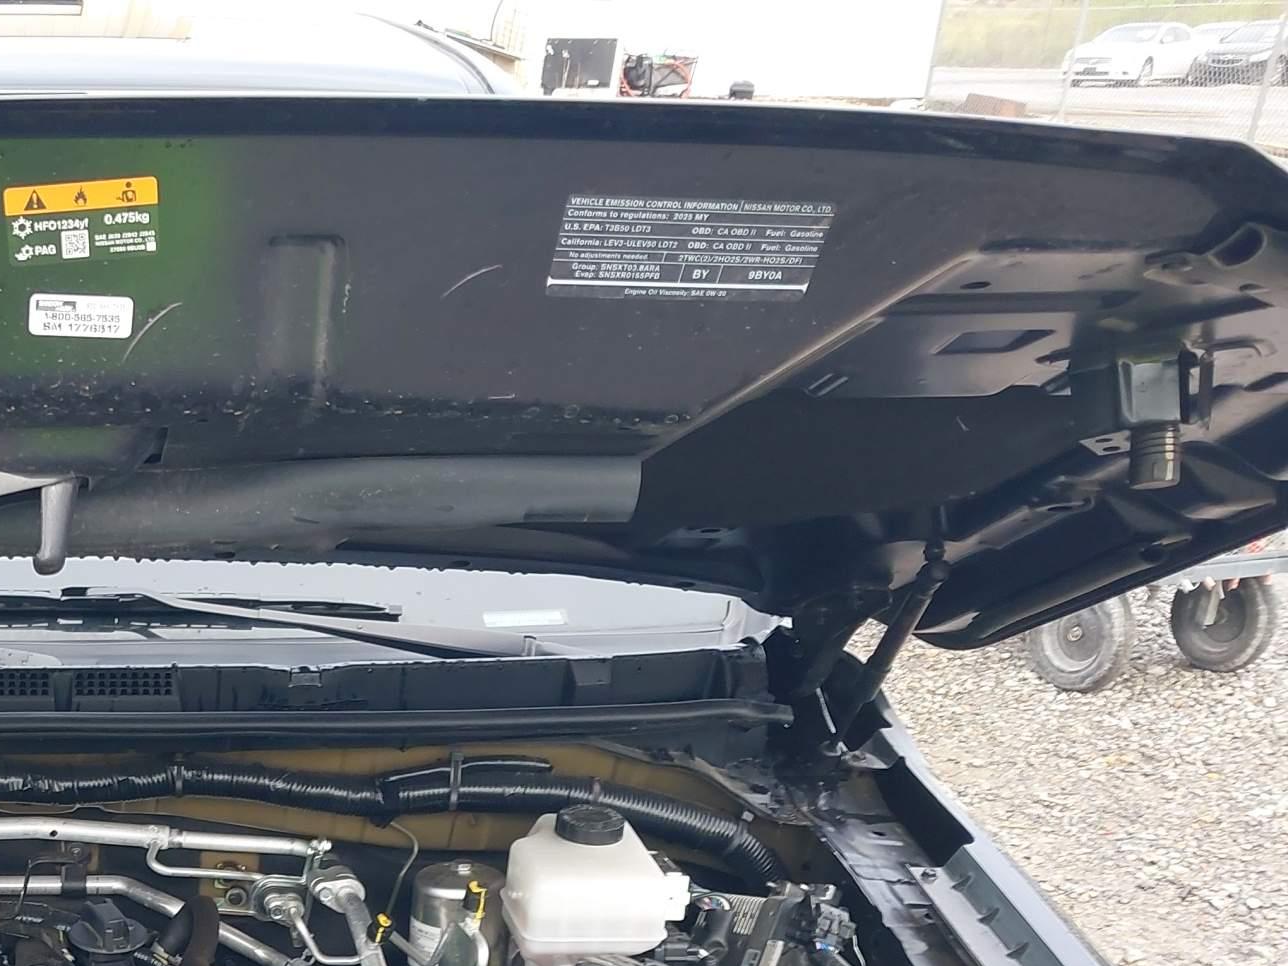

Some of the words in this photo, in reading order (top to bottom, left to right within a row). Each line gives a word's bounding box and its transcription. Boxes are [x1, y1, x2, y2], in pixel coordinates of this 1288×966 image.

[571, 197, 605, 206] VEHICLE
[605, 199, 644, 207] EMISSION
[646, 200, 682, 208] CONTROL
[683, 201, 738, 211] INFORMATION
[744, 203, 772, 211] NISSAN
[773, 204, 800, 212] MOTOR
[103, 212, 150, 225] 0.475kg
[567, 209, 607, 218] Conforms
[609, 210, 618, 218] to
[620, 210, 669, 220] regulations:
[673, 213, 693, 221] 2025
[694, 213, 709, 221] MY
[33, 218, 89, 231] HFO1234yf
[564, 223, 581, 231] U.S.
[583, 223, 603, 232] EPA:
[631, 225, 652, 233] LDT3
[692, 227, 713, 235] OBD:
[717, 228, 729, 236] CA
[730, 228, 749, 236] OBD
[765, 229, 787, 237] Fuel:
[790, 230, 824, 238] Gasoline
[561, 238, 602, 247] California:
[657, 240, 679, 249] LDT2
[687, 241, 709, 249] OBD:
[712, 242, 724, 250] CA
[725, 242, 745, 250] OBD
[760, 243, 782, 251] Fuel:
[784, 244, 819, 252] Gasoline
[34, 245, 57, 256] PAG
[580, 252, 621, 260] adjustments
[572, 262, 598, 271] Group:
[575, 271, 596, 279] Evap:
[692, 269, 710, 280] BY
[624, 288, 647, 296] Engine
